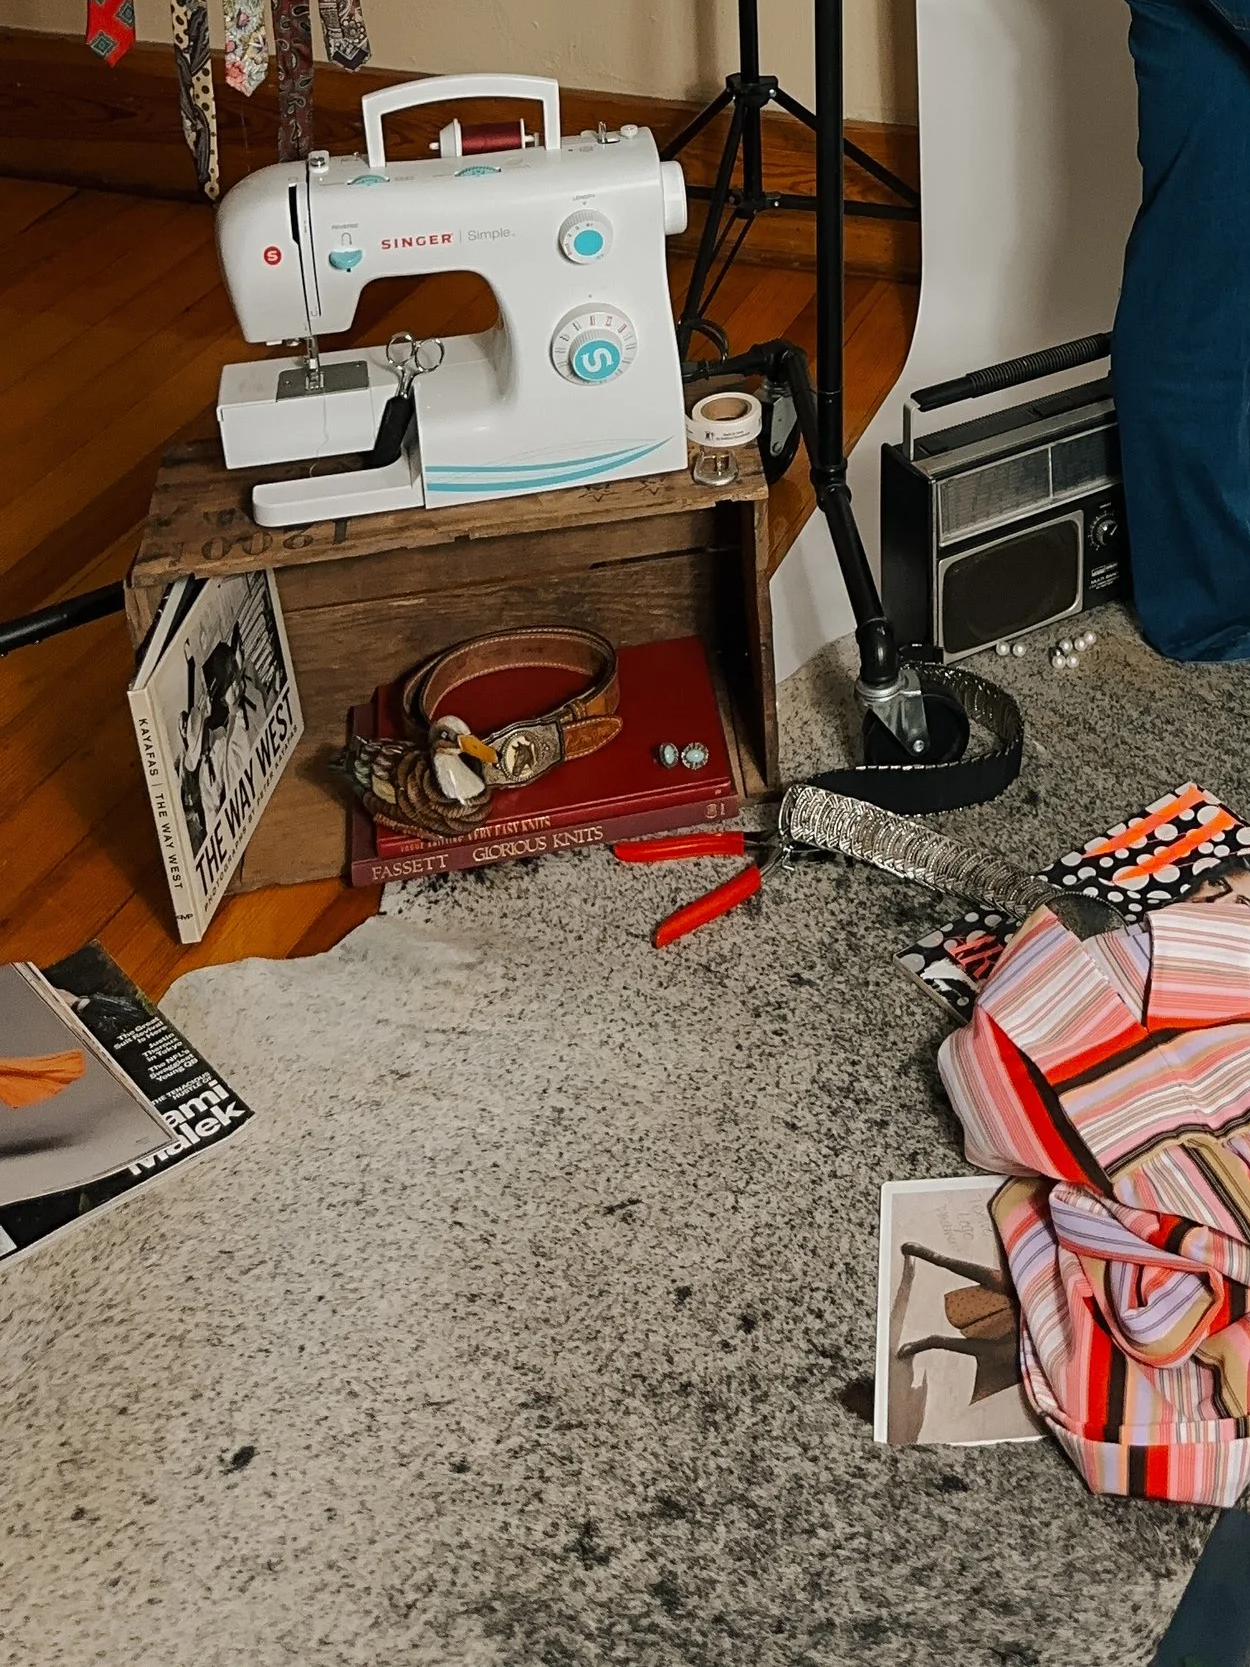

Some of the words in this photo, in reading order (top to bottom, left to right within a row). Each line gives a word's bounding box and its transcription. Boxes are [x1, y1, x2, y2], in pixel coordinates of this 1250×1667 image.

[381, 233, 453, 250] SINGER
[195, 819, 228, 896] THE
[225, 758, 256, 838] WAY
[255, 687, 293, 778] WEST
[138, 718, 159, 777] KAYAFAS
[154, 793, 168, 818] THE
[161, 823, 175, 850] WAY
[168, 855, 184, 890] WEST
[372, 853, 449, 881] FASSETT
[472, 836, 547, 863] GLORIOUS
[553, 825, 604, 849] KNITS
[203, 825, 247, 912] PHOTOGRAPHS
[141, 1037, 180, 1058] Theroux
[148, 1032, 175, 1048] Justin
[156, 1040, 183, 1059] Tokyo
[147, 1062, 167, 1073] The
[149, 1053, 195, 1080] Swaggiest
[155, 1066, 185, 1083] Young
[166, 1071, 211, 1098] TENACIOUS
[172, 1082, 203, 1100] HUSTLE
[162, 1079, 230, 1128] ami
